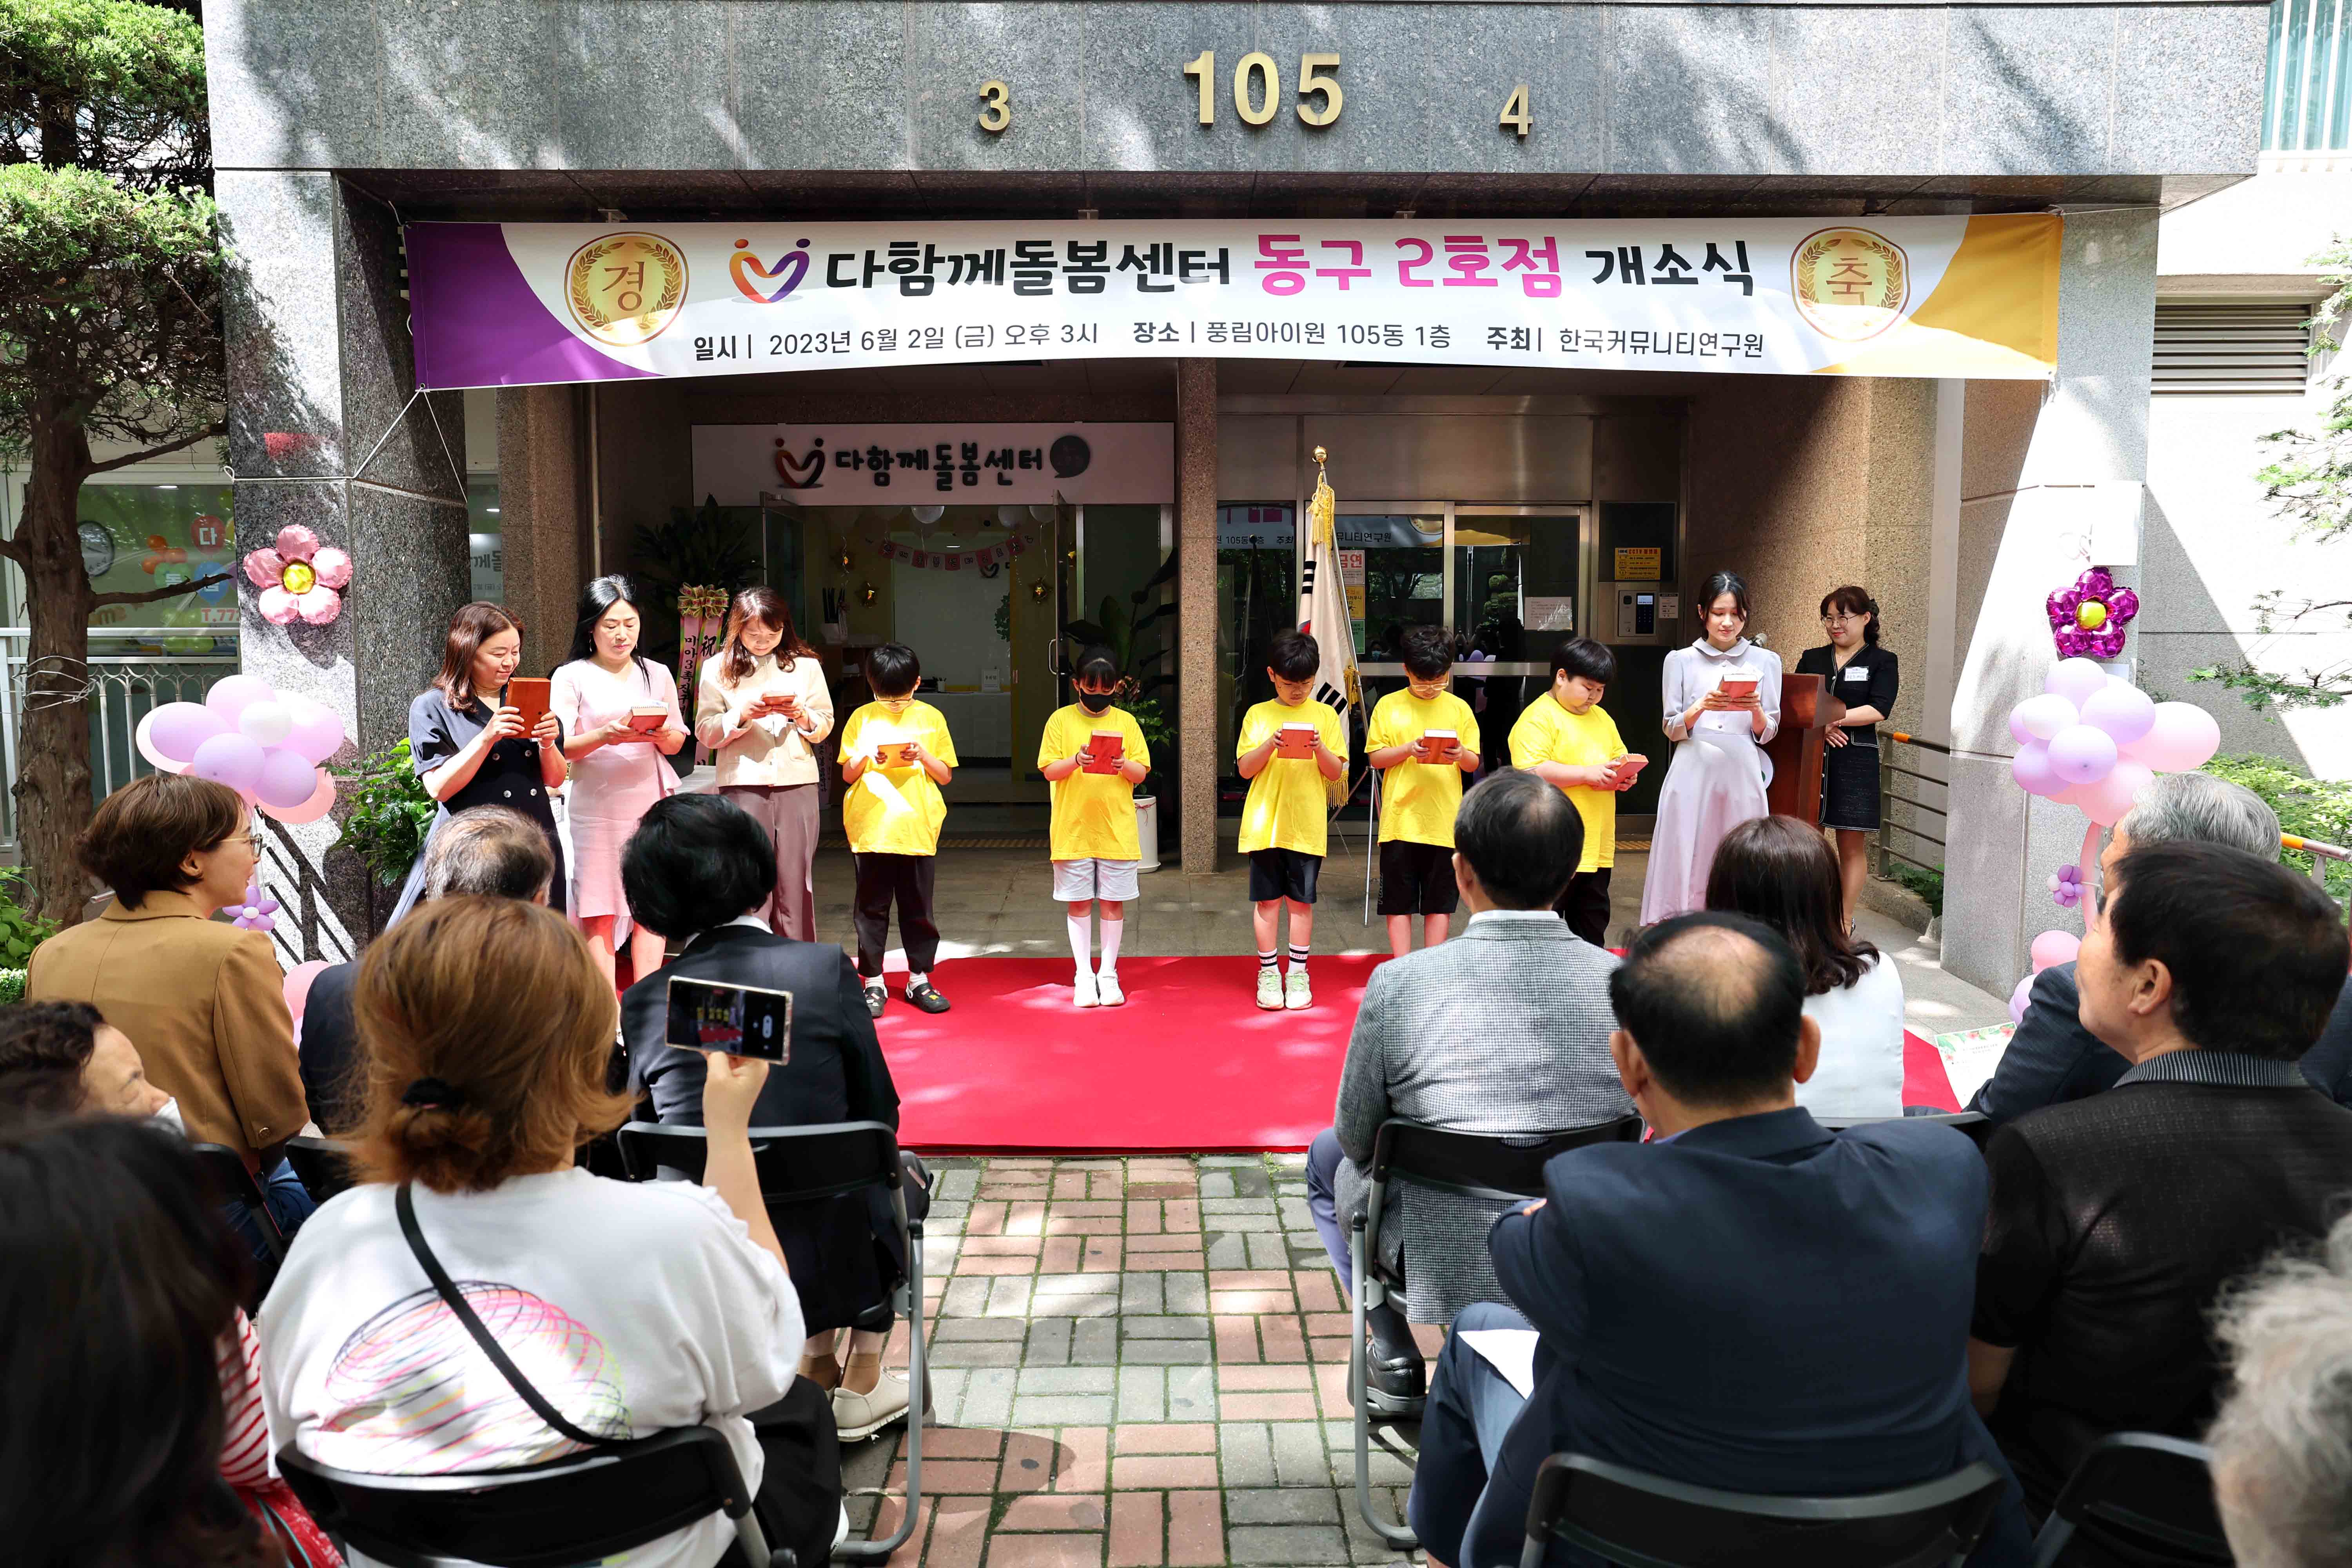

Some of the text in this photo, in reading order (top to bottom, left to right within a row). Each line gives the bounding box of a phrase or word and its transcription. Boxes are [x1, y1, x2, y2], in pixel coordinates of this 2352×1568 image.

[978, 79, 1011, 134] 3
[1183, 49, 1344, 127] 105
[1499, 84, 1533, 136] 4
[602, 261, 645, 311] 경
[826, 234, 1754, 298] 다함께돌봄센터 동구 2호점 개소식
[1826, 258, 1873, 306] 축
[769, 330, 851, 355] 2023년
[861, 328, 897, 351] 6월
[908, 327, 944, 349] 2일
[955, 324, 994, 349] (금)
[1005, 323, 1051, 345] 오후
[1060, 323, 1097, 344] 3시
[1207, 321, 1325, 345] 풍림아이원
[1337, 324, 1404, 347] 105동
[1415, 324, 1451, 348] 1층
[1559, 328, 1763, 358] 한국커뮤니티연구원
[835, 442, 1043, 492] 다함께돌봄센터
[701, 635, 717, 657] 祝
